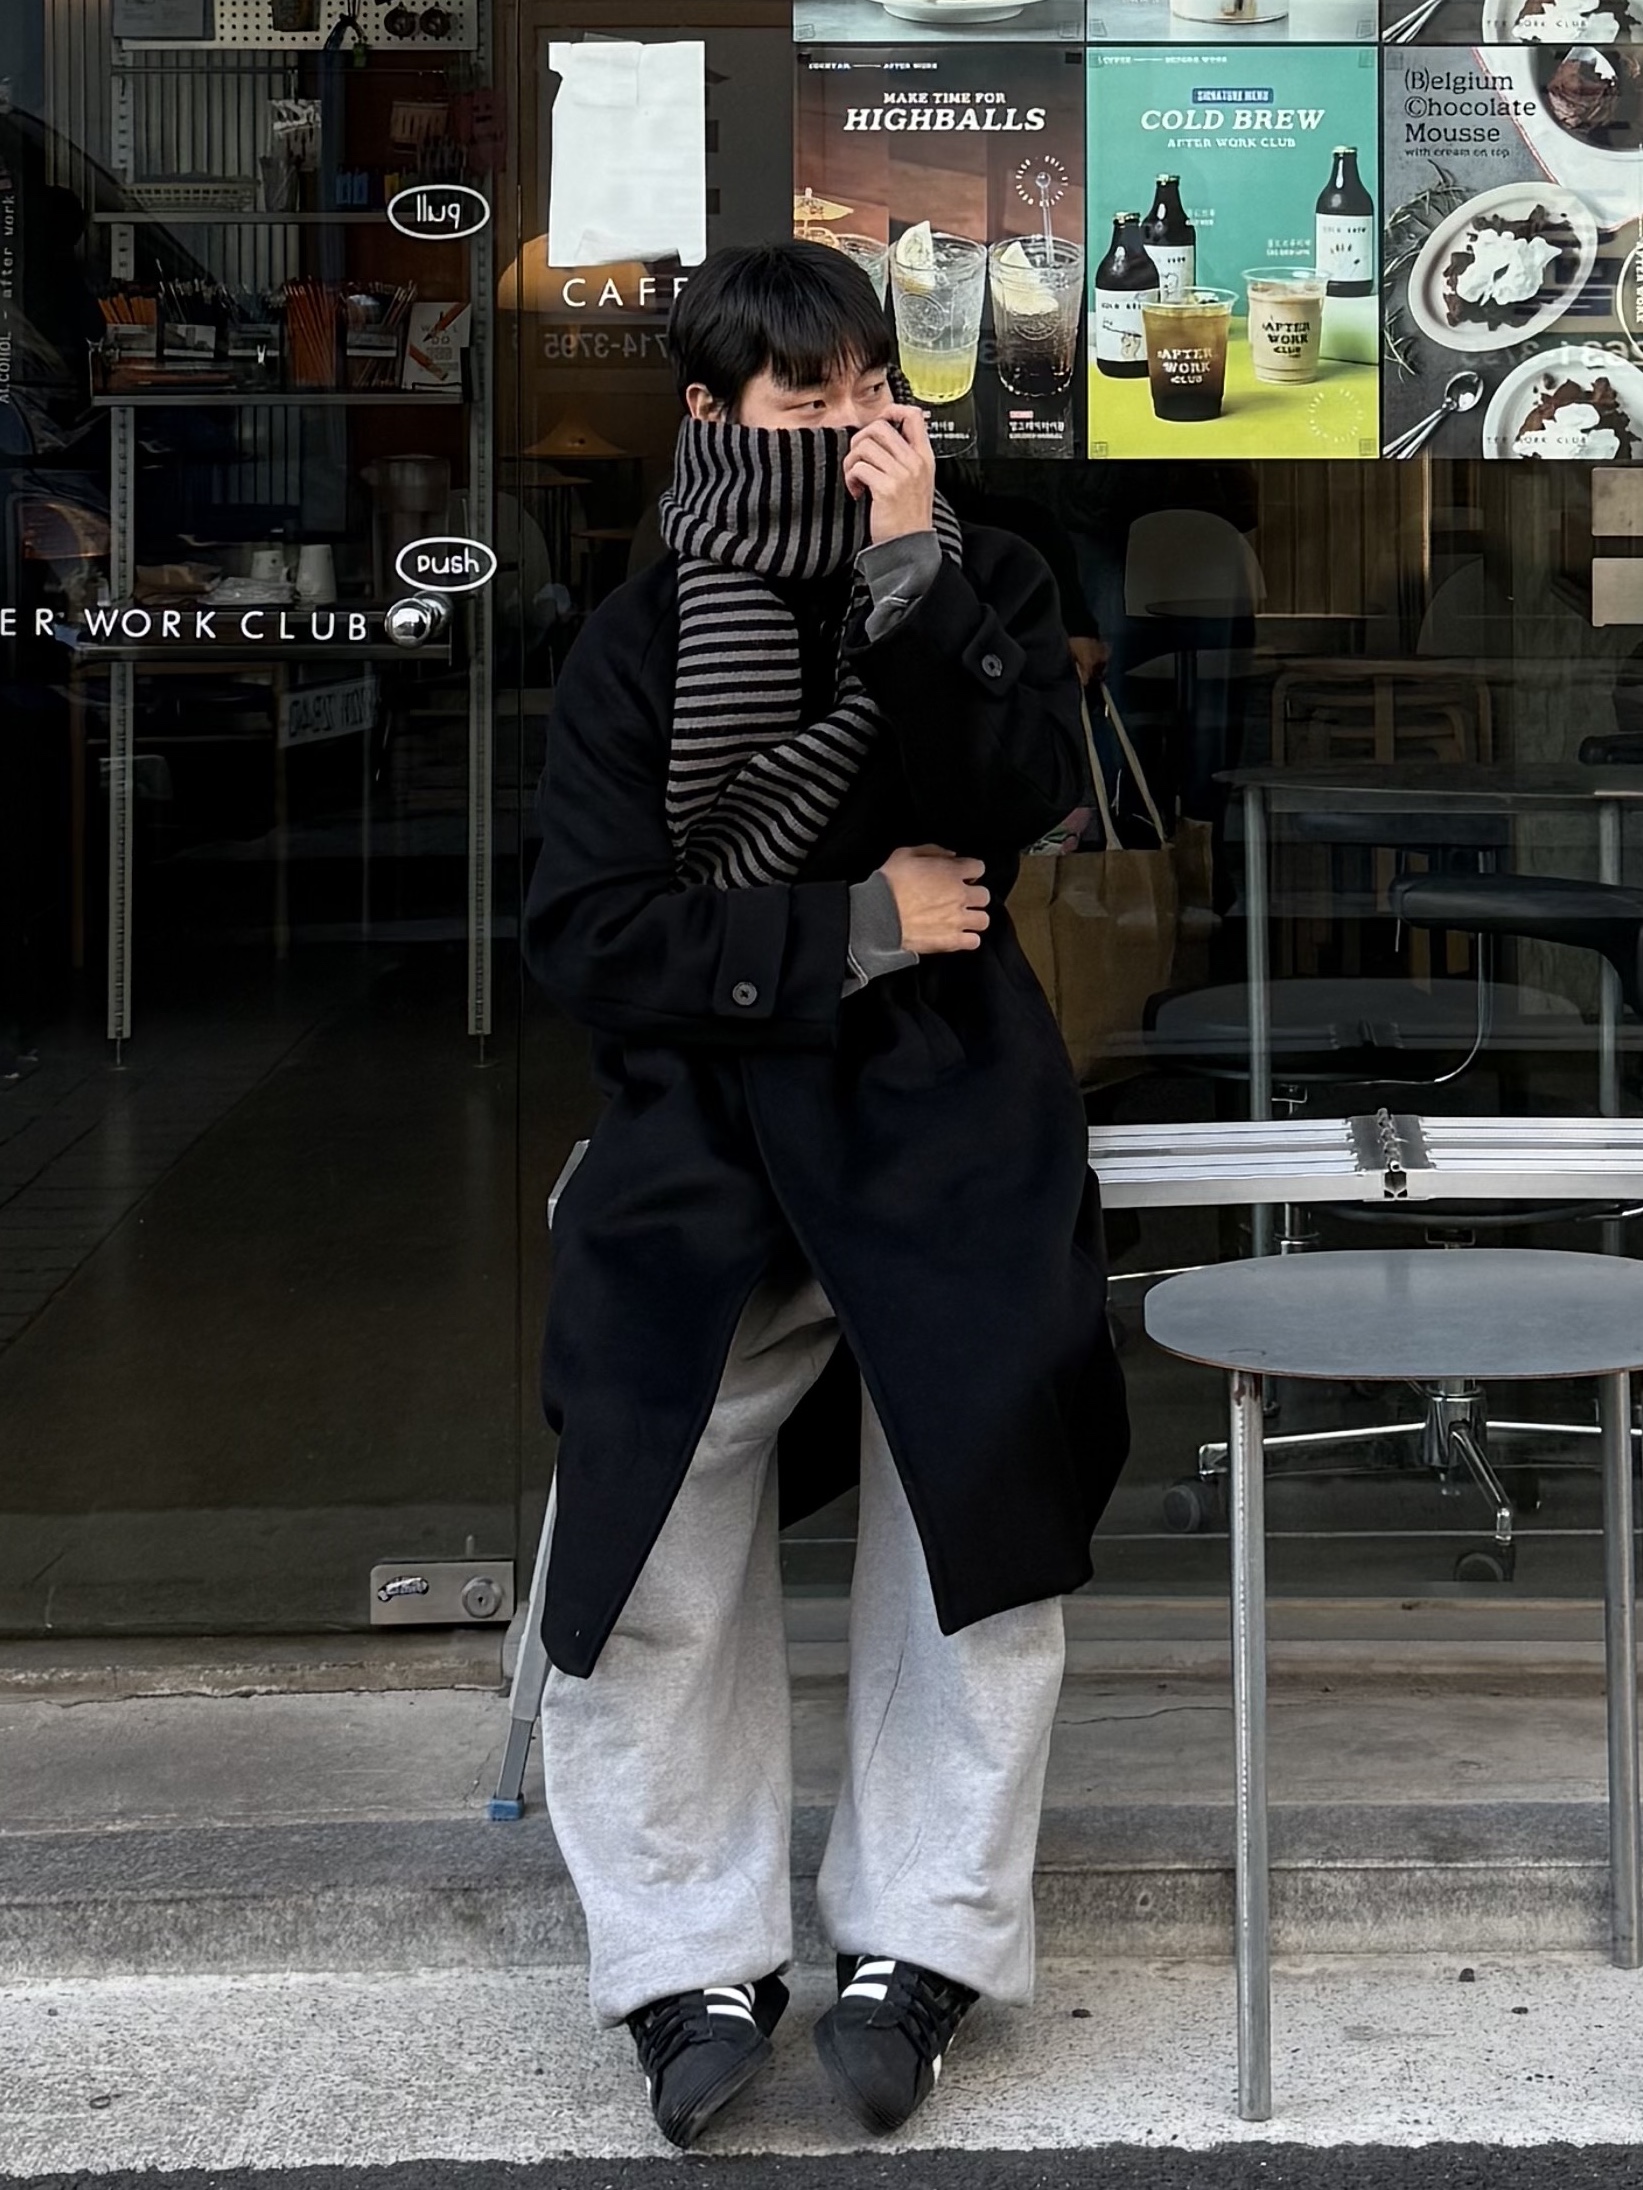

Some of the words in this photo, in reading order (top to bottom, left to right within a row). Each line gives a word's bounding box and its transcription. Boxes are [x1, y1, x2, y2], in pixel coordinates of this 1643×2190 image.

[1404, 67, 1513, 94] (B)elgium
[883, 92, 929, 104] MAKE
[932, 92, 971, 104] TIME
[975, 92, 1006, 104] FOR
[843, 107, 1046, 131] HIGHBALLS
[1140, 109, 1225, 130] COLD
[1232, 109, 1326, 130] BREW
[1167, 137, 1212, 149] AFTER
[1215, 137, 1257, 148] WORK
[1260, 137, 1296, 148] CLUB
[1405, 122, 1501, 143] Mousse
[1404, 148, 1431, 157] with
[1, 607, 54, 636] ER
[85, 608, 216, 639] WORK
[240, 610, 367, 641] CLUB
